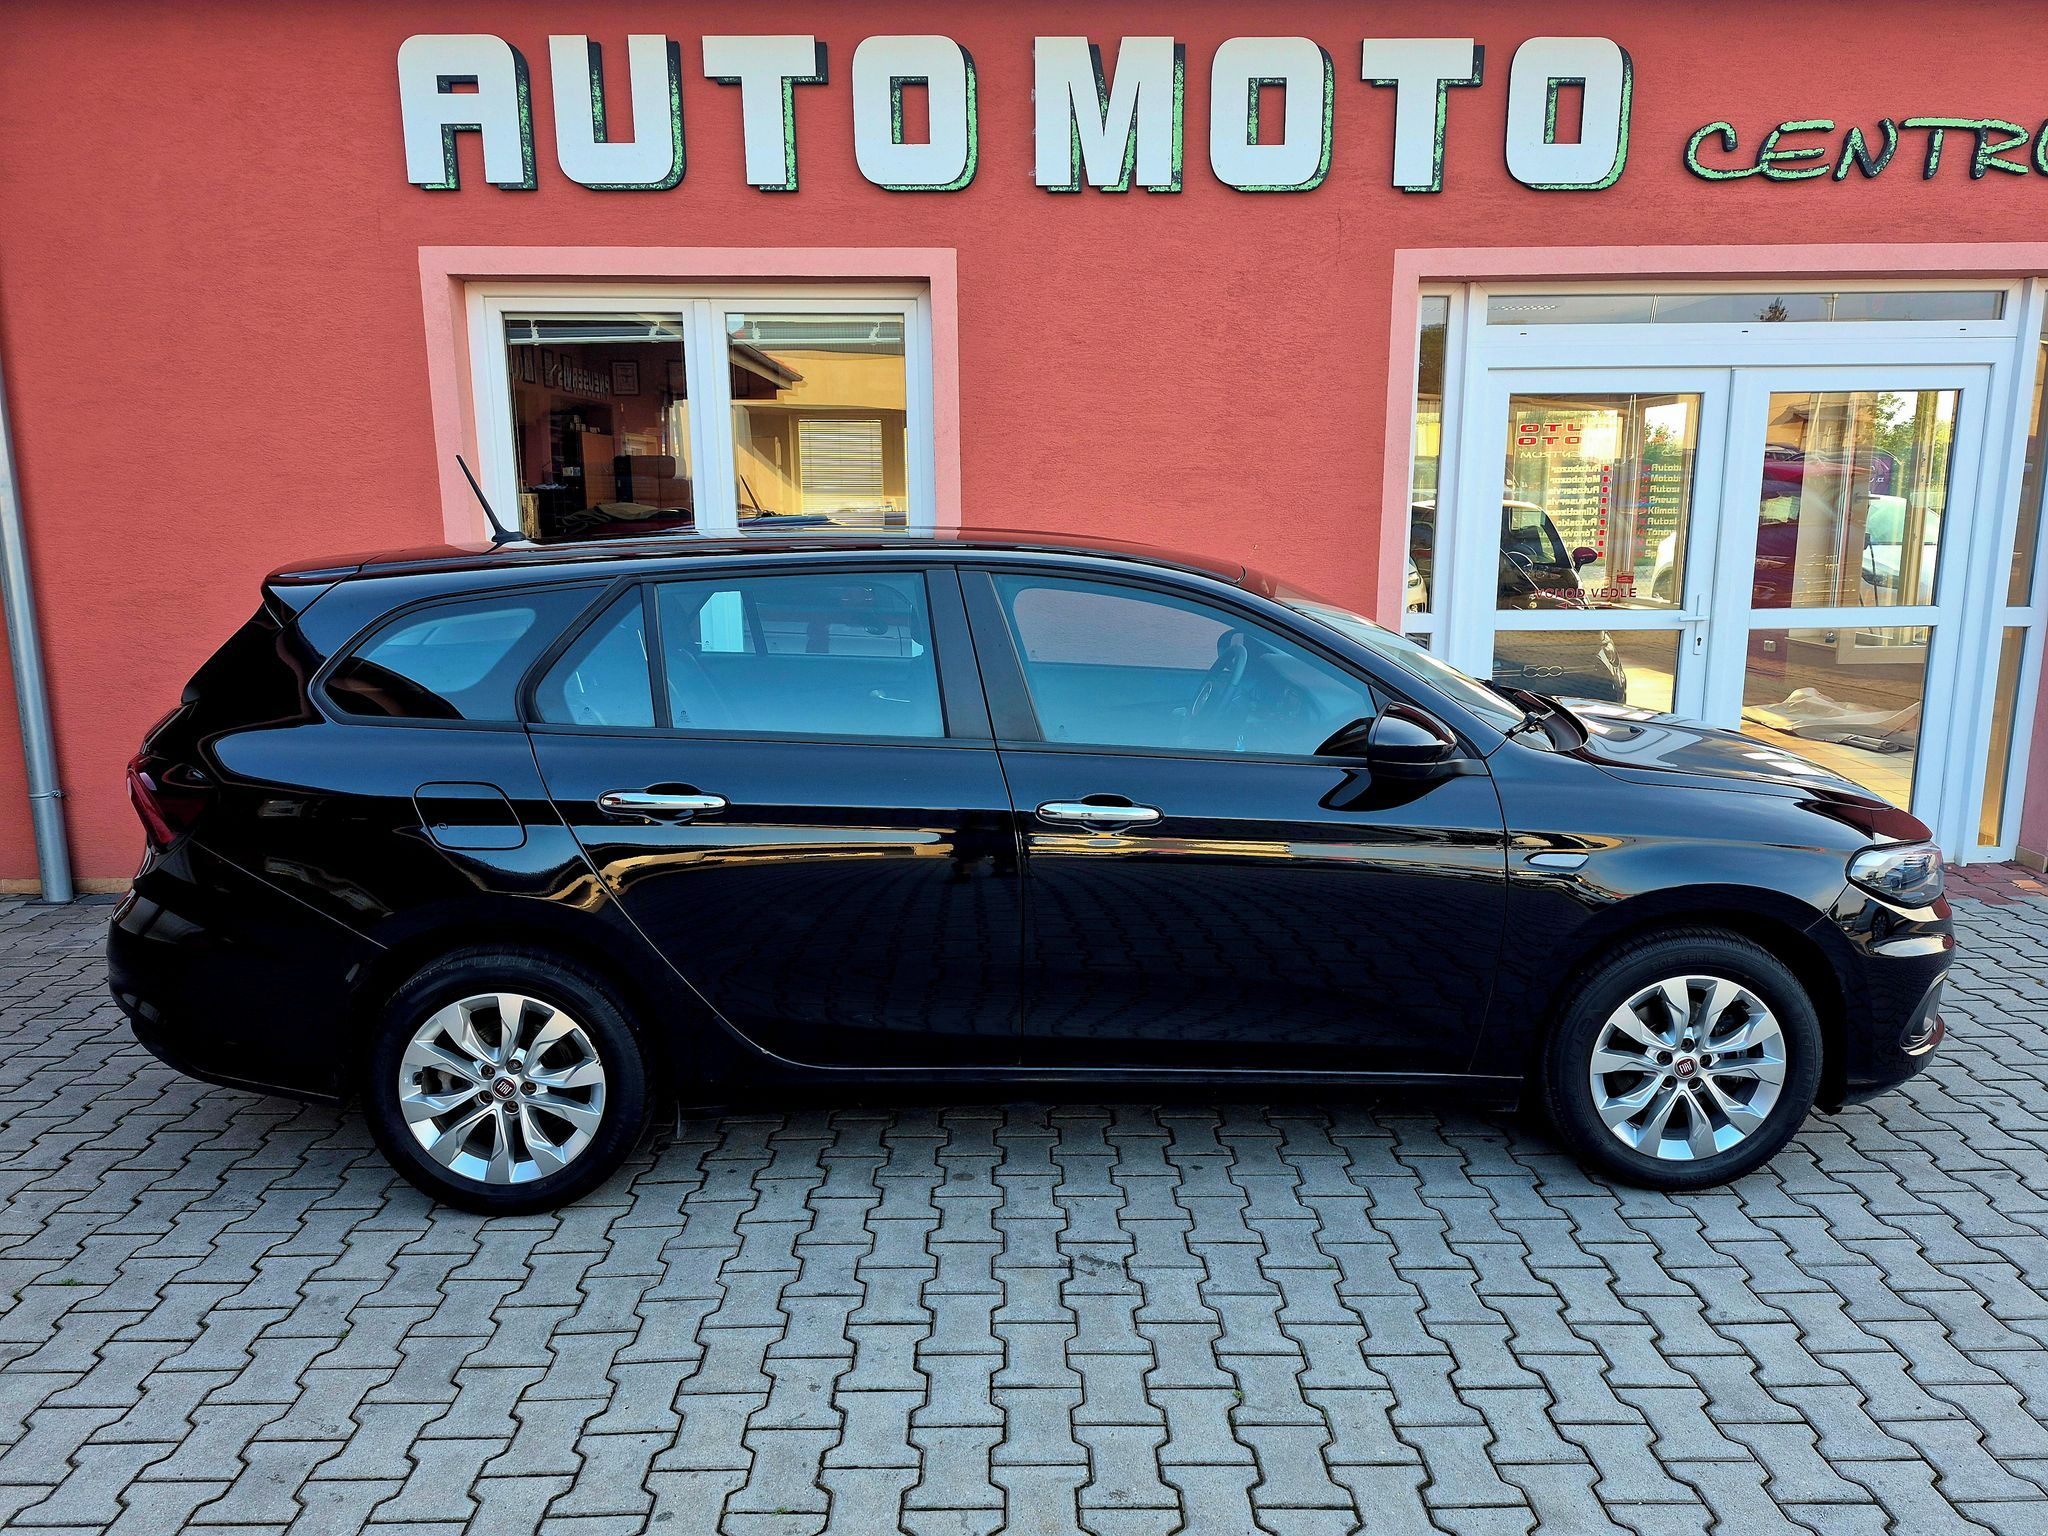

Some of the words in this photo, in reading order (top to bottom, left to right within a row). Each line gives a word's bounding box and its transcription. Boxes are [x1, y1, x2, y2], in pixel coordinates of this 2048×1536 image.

[398, 34, 977, 191] AUTO
[1034, 35, 1631, 193] MOTO
[1684, 117, 2048, 182] CENTR
[1535, 587, 1585, 598] VCHOD
[1591, 587, 1637, 598] VEDLE
[1522, 664, 1564, 678] 500
[1679, 1061, 1692, 1074] FIAT
[497, 1082, 512, 1095] FIAT
